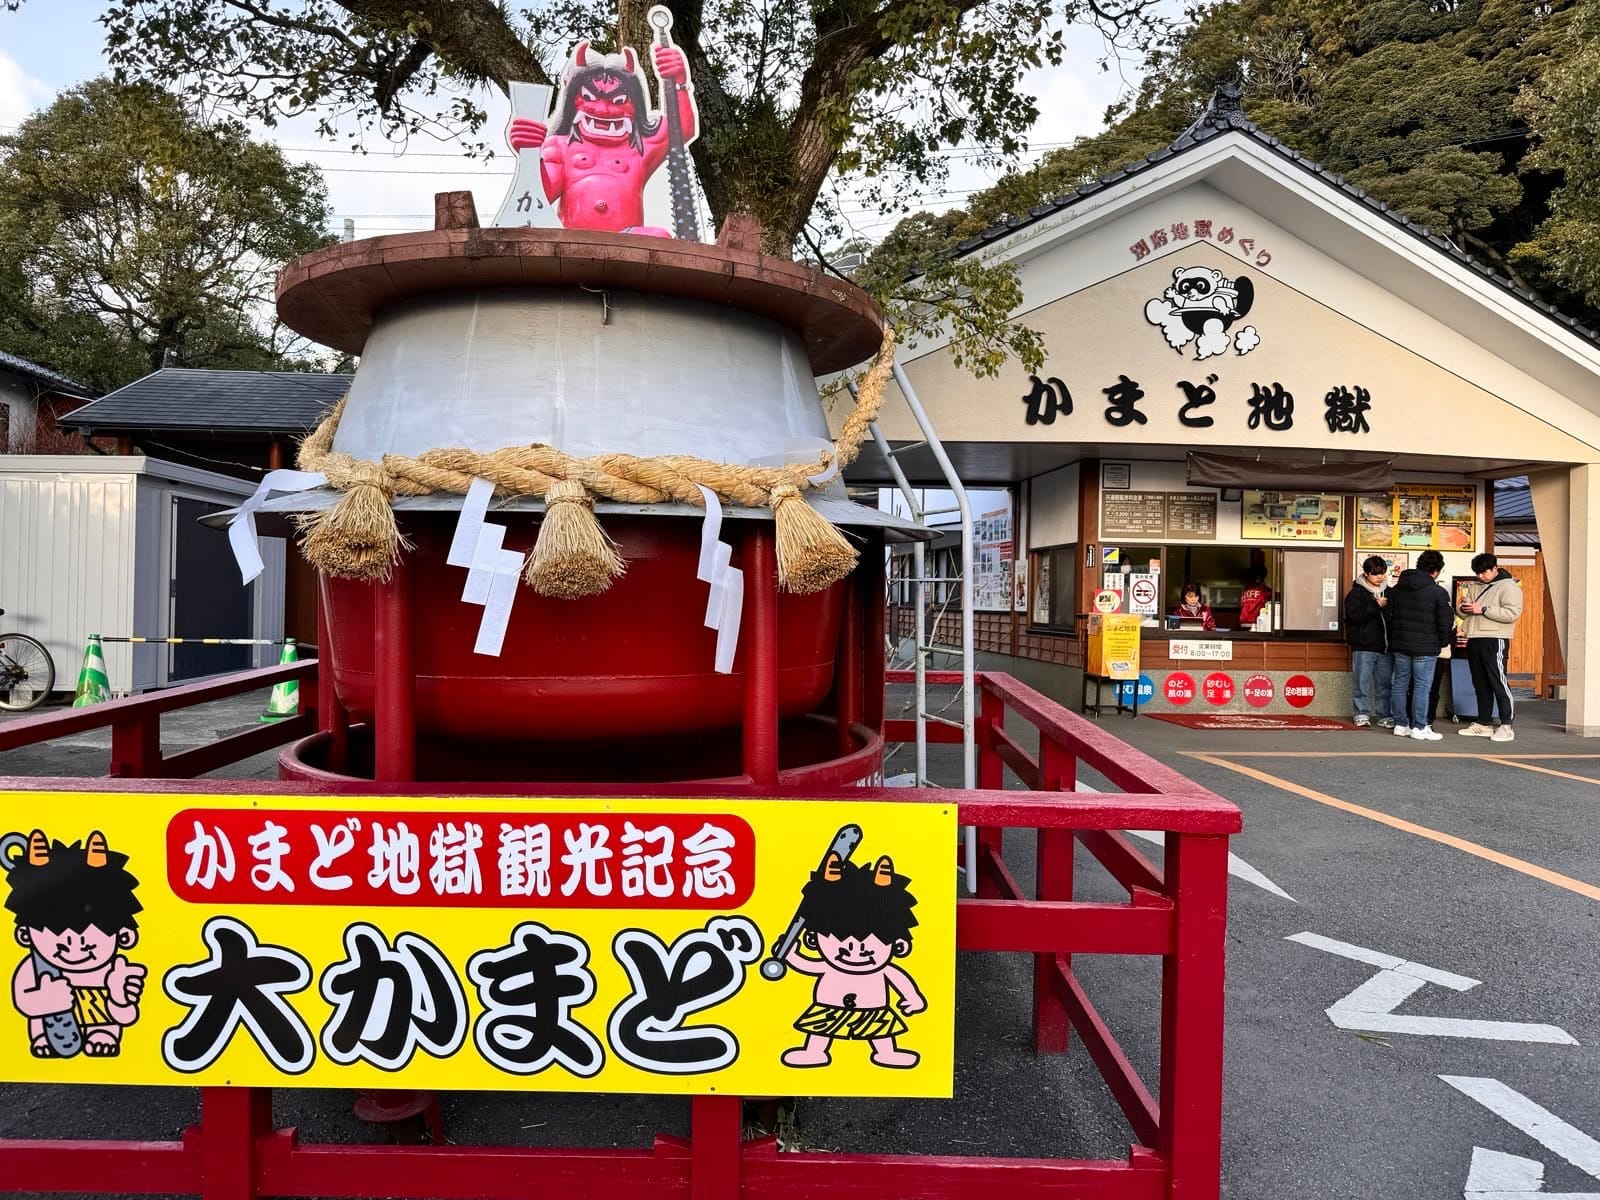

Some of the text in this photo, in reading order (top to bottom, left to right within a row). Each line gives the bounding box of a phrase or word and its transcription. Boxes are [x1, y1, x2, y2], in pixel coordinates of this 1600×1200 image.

[516, 190, 544, 228] か
[1129, 219, 1272, 267] 別府地獄めぐり
[1022, 373, 1372, 434] かまど地獄
[1172, 644, 1188, 655] 受付
[183, 820, 737, 899] かまど地獄観光記念
[160, 914, 764, 1077] 大かまど
